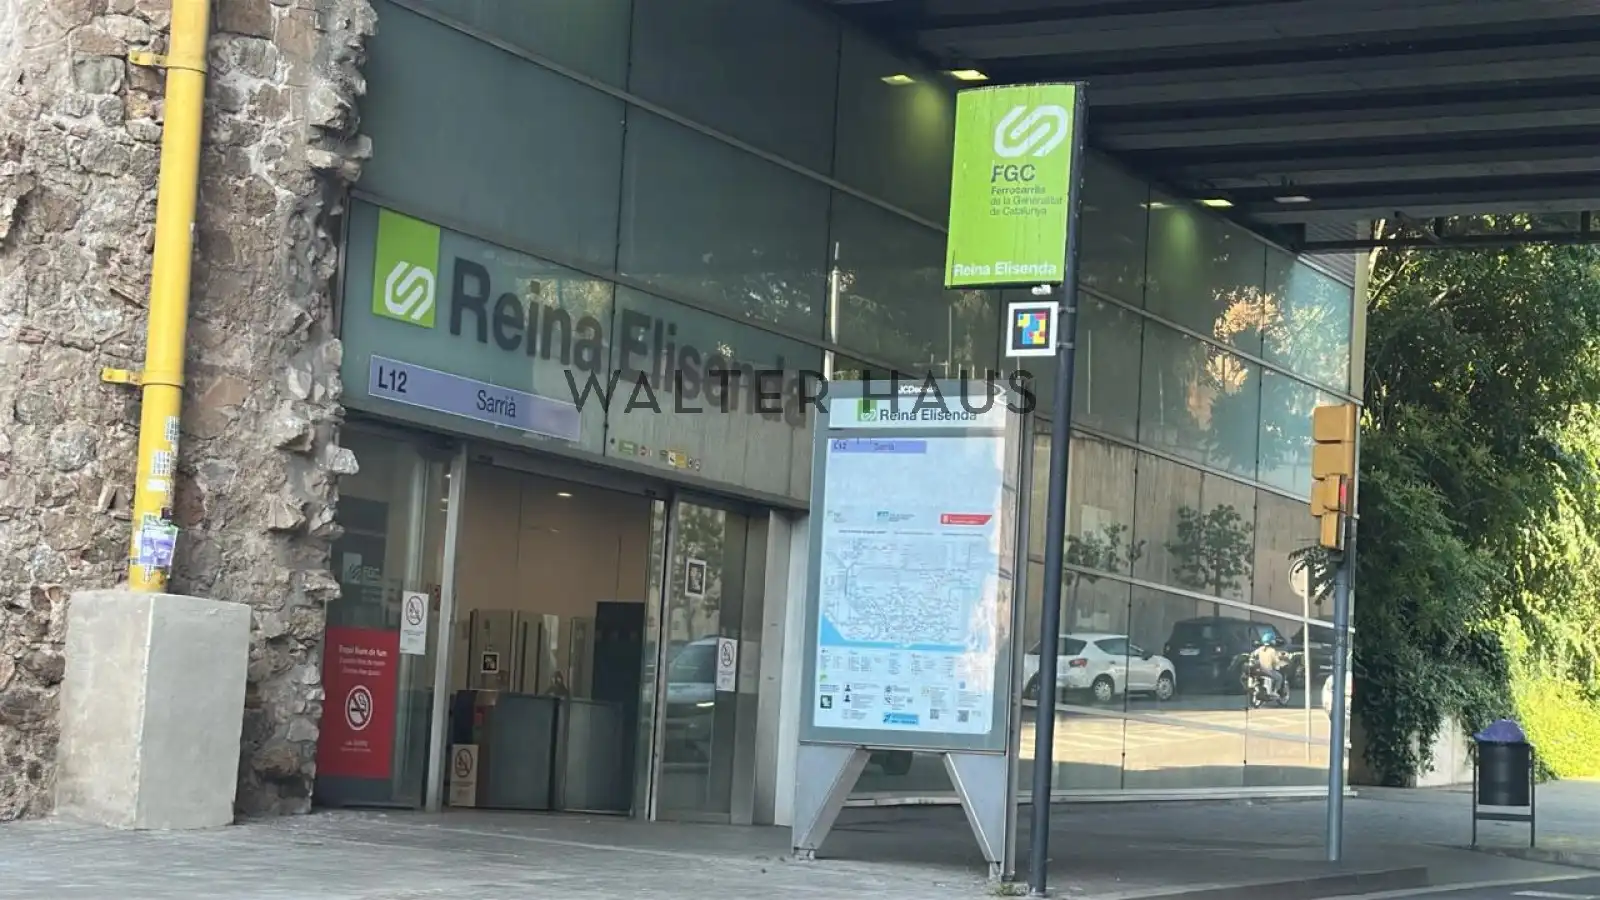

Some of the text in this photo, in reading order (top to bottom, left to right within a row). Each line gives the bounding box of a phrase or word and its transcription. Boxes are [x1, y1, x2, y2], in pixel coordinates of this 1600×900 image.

[991, 164, 1036, 183] FGC
[953, 260, 1057, 276] Reina Elisenda
[449, 256, 807, 429] Reina Elisenda
[378, 366, 408, 394] L12
[880, 408, 977, 422] Reina Elisenda
